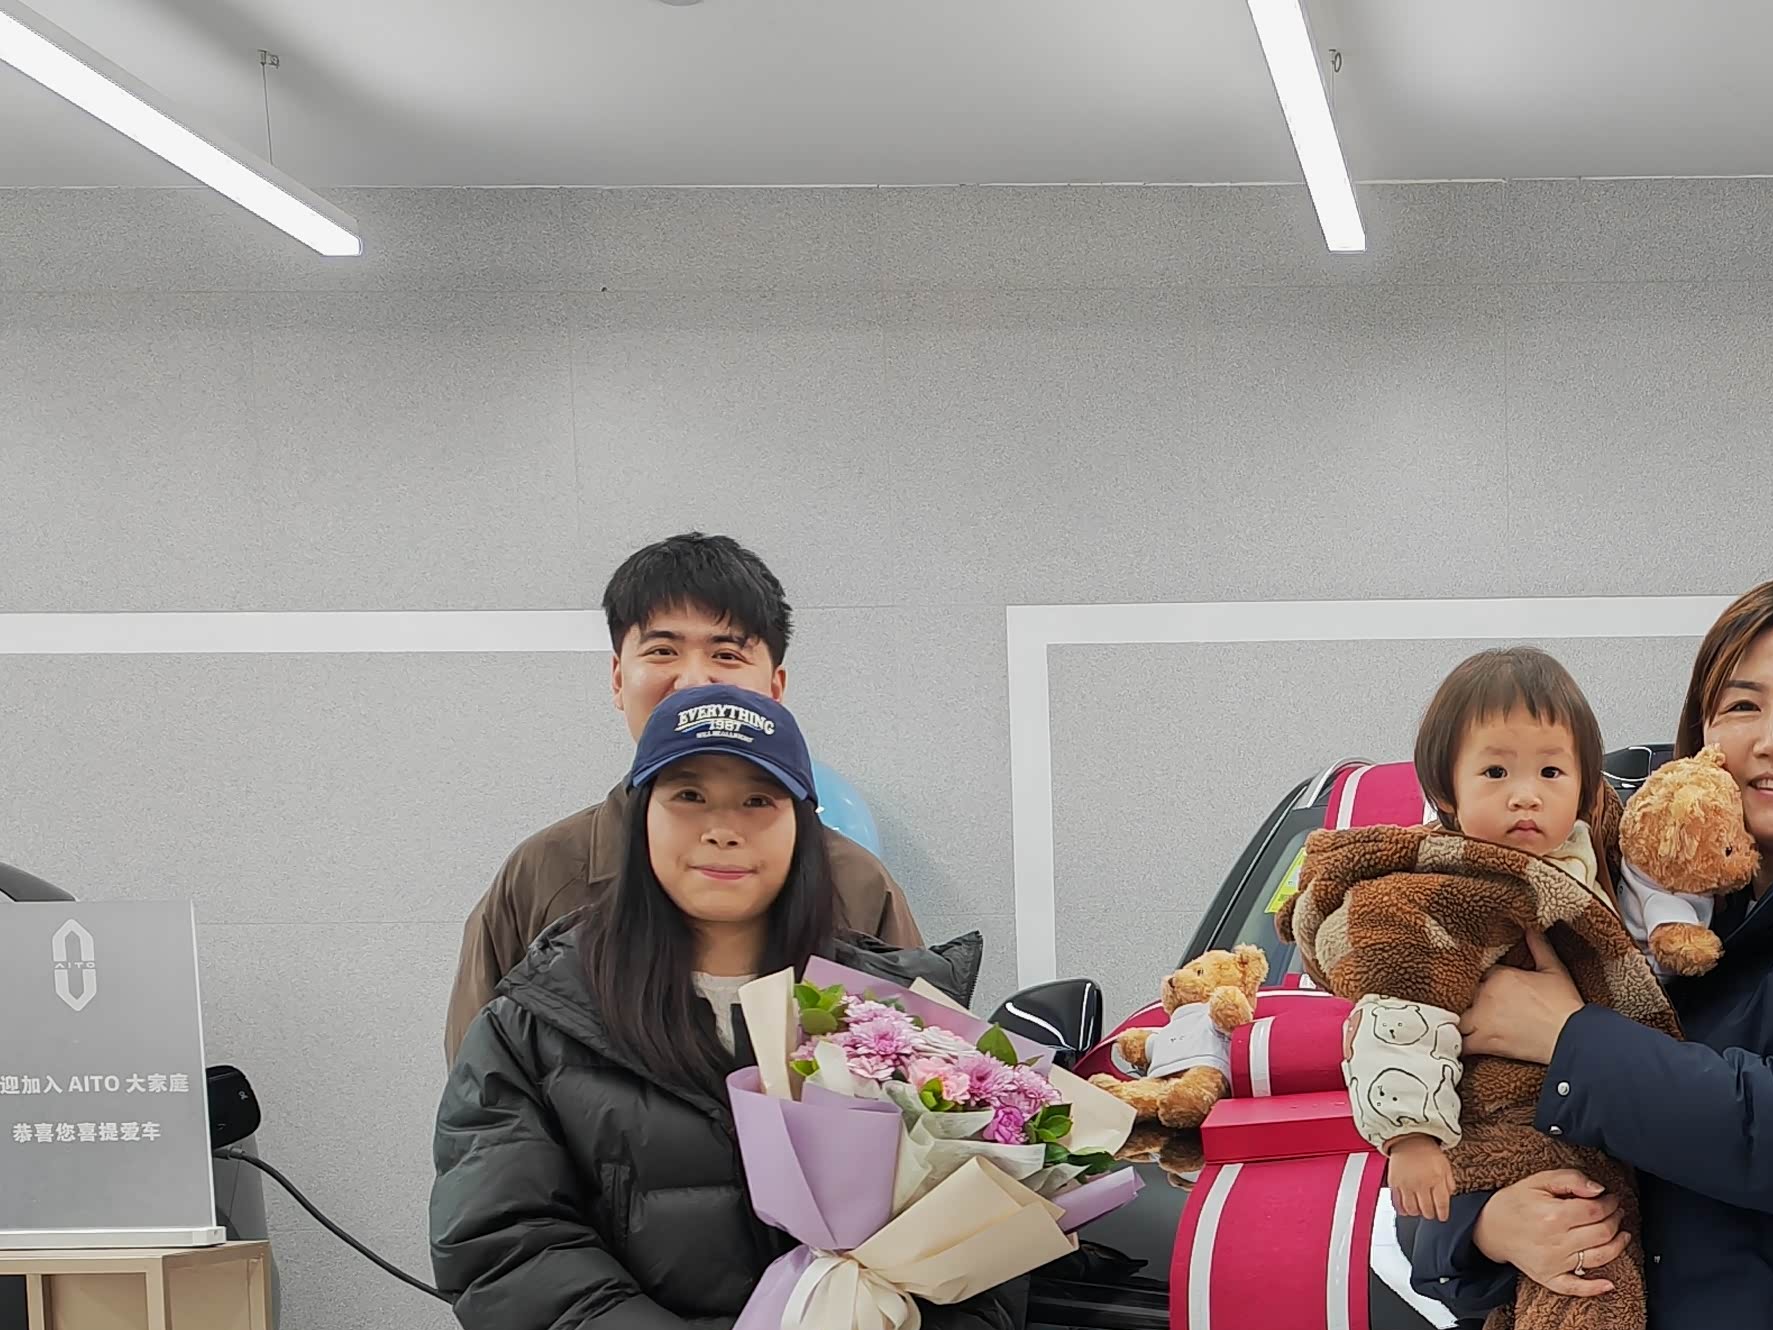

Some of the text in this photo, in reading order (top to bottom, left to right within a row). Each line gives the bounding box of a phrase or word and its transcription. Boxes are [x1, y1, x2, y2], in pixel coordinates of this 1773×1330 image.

[677, 704, 775, 735] EVERYTHING
[0, 1073, 190, 1094] 迎加入 AITO 大家庭
[13, 1122, 161, 1143] 恭喜您喜提爱车
